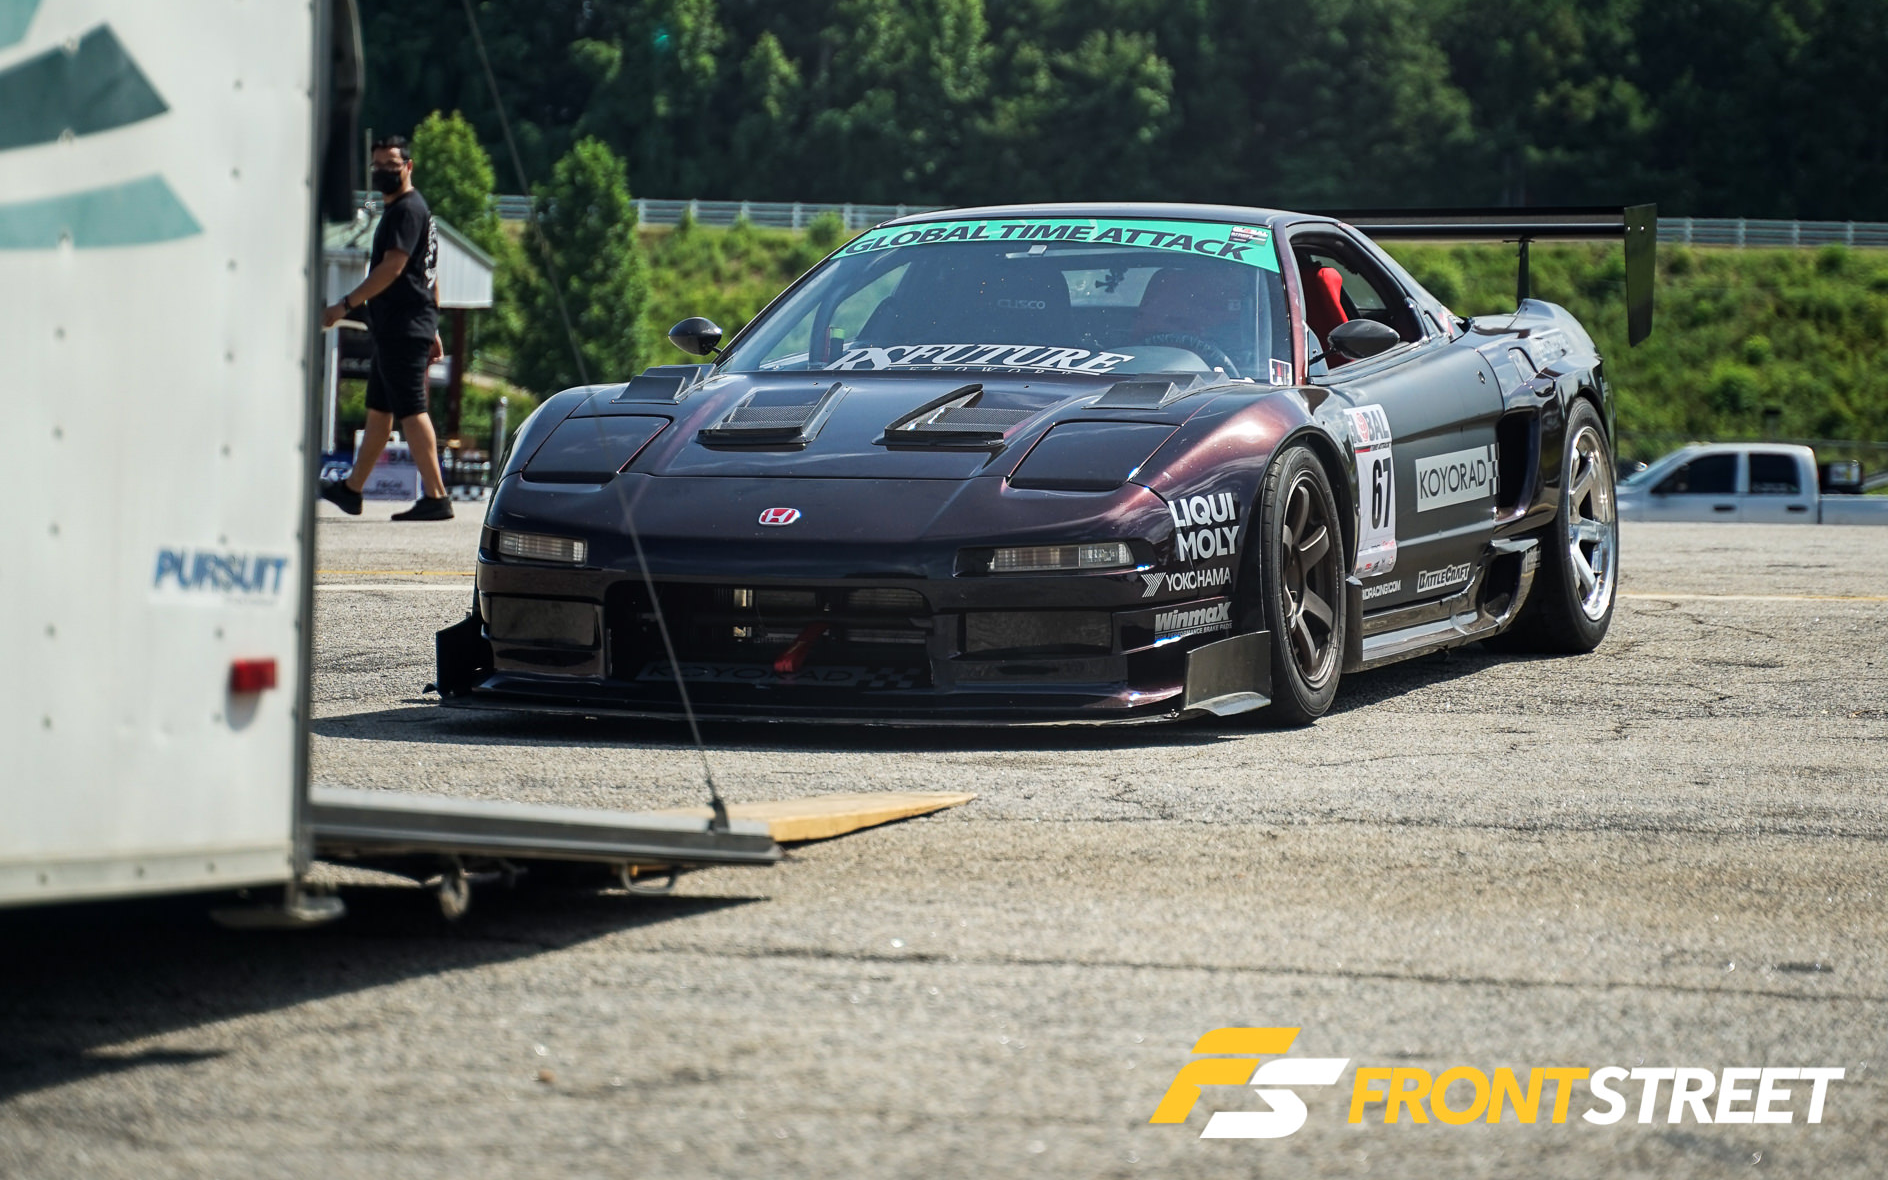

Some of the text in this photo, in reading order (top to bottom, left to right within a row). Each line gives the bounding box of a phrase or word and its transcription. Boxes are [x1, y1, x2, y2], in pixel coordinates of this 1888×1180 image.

[845, 224, 1253, 262] GLOBAL TIME ATTACK
[1371, 457, 1393, 531] 67
[1419, 459, 1487, 500] KOYORAD
[1167, 492, 1236, 528] LIQUI
[1177, 525, 1240, 562] MOLY
[154, 548, 289, 594] PURSUIT
[1166, 566, 1232, 592] YOKOHAMA
